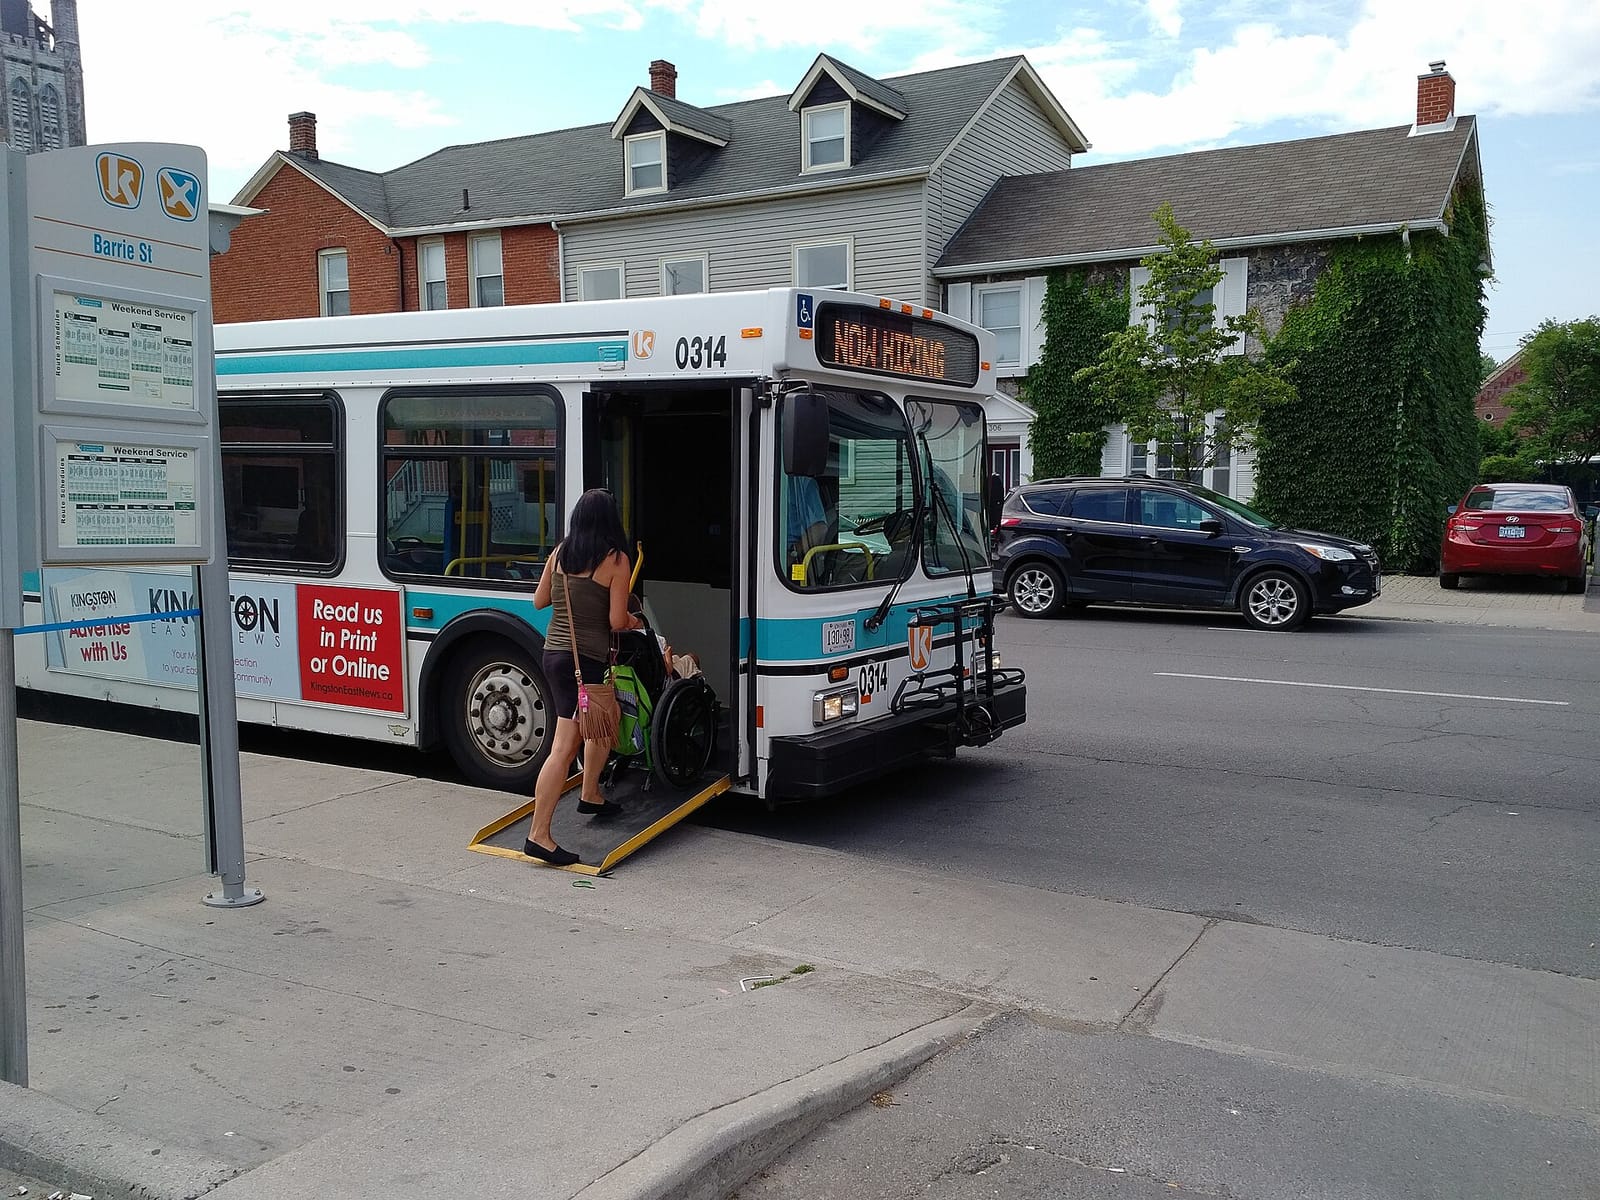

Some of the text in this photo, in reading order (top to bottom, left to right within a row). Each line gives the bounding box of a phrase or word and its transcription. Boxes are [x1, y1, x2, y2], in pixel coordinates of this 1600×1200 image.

[94, 233, 153, 263] Barrie St
[112, 303, 152, 317] Weekend
[154, 309, 187, 322] Service
[675, 335, 727, 370] 0314
[834, 320, 945, 379] NOW HIRING
[113, 446, 154, 458] Weekend
[156, 449, 188, 459] Service
[70, 590, 116, 607] KINGSTON
[312, 598, 383, 625] Read us
[80, 641, 128, 661] with Us
[238, 632, 280, 648] EWS
[319, 625, 377, 652] in Print
[171, 649, 188, 659] Your
[310, 654, 390, 681] or Online
[860, 661, 888, 696] 0314
